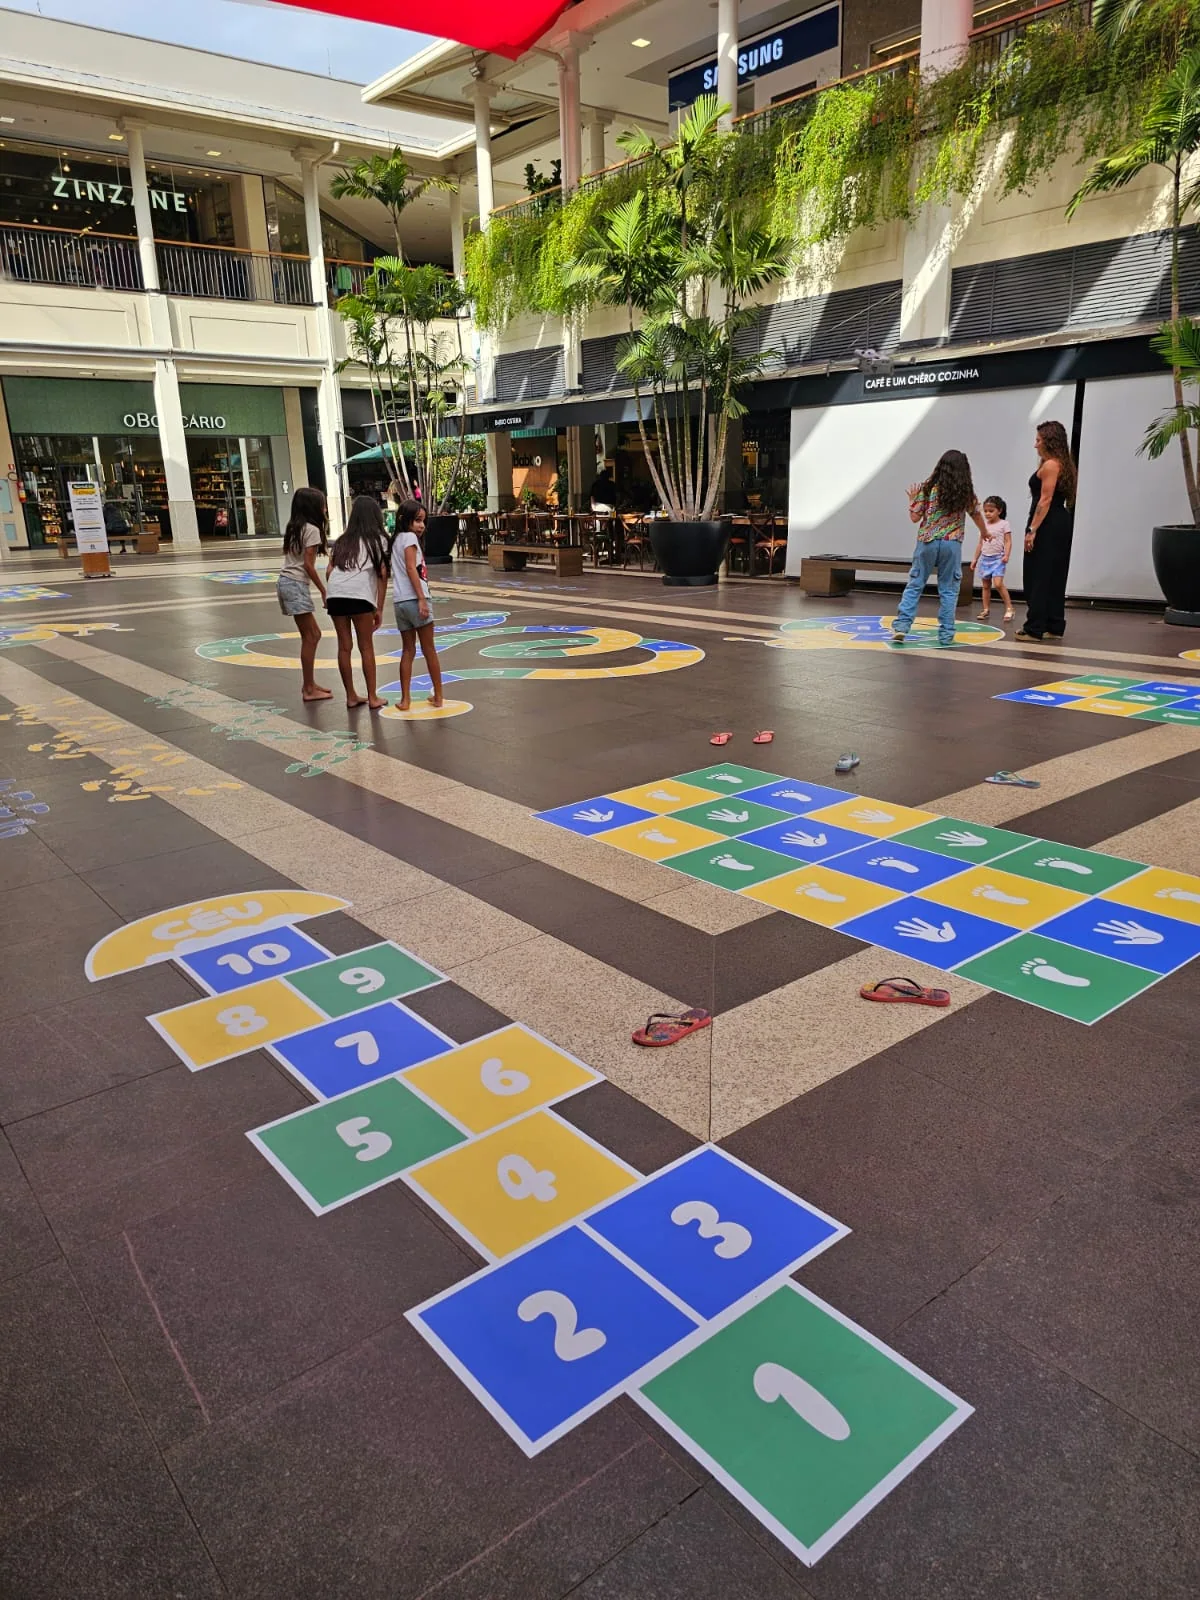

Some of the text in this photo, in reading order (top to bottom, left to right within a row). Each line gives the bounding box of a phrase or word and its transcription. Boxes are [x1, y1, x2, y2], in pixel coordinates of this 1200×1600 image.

[703, 38, 783, 90] SSUNG
[51, 176, 187, 212] ZINZNE
[865, 377, 884, 389] CAFÉ
[886, 378, 891, 387] E
[892, 377, 906, 386] UM
[938, 369, 979, 381] COZINHA
[217, 943, 291, 975] 10
[339, 967, 385, 993] 9
[216, 1005, 268, 1036] 8
[334, 1030, 379, 1065] 7
[481, 1058, 531, 1095] 6
[336, 1116, 392, 1162] 5
[497, 1154, 557, 1202] 4
[670, 1200, 752, 1259] 3
[517, 1290, 607, 1362] 2
[753, 1362, 851, 1441] 1
